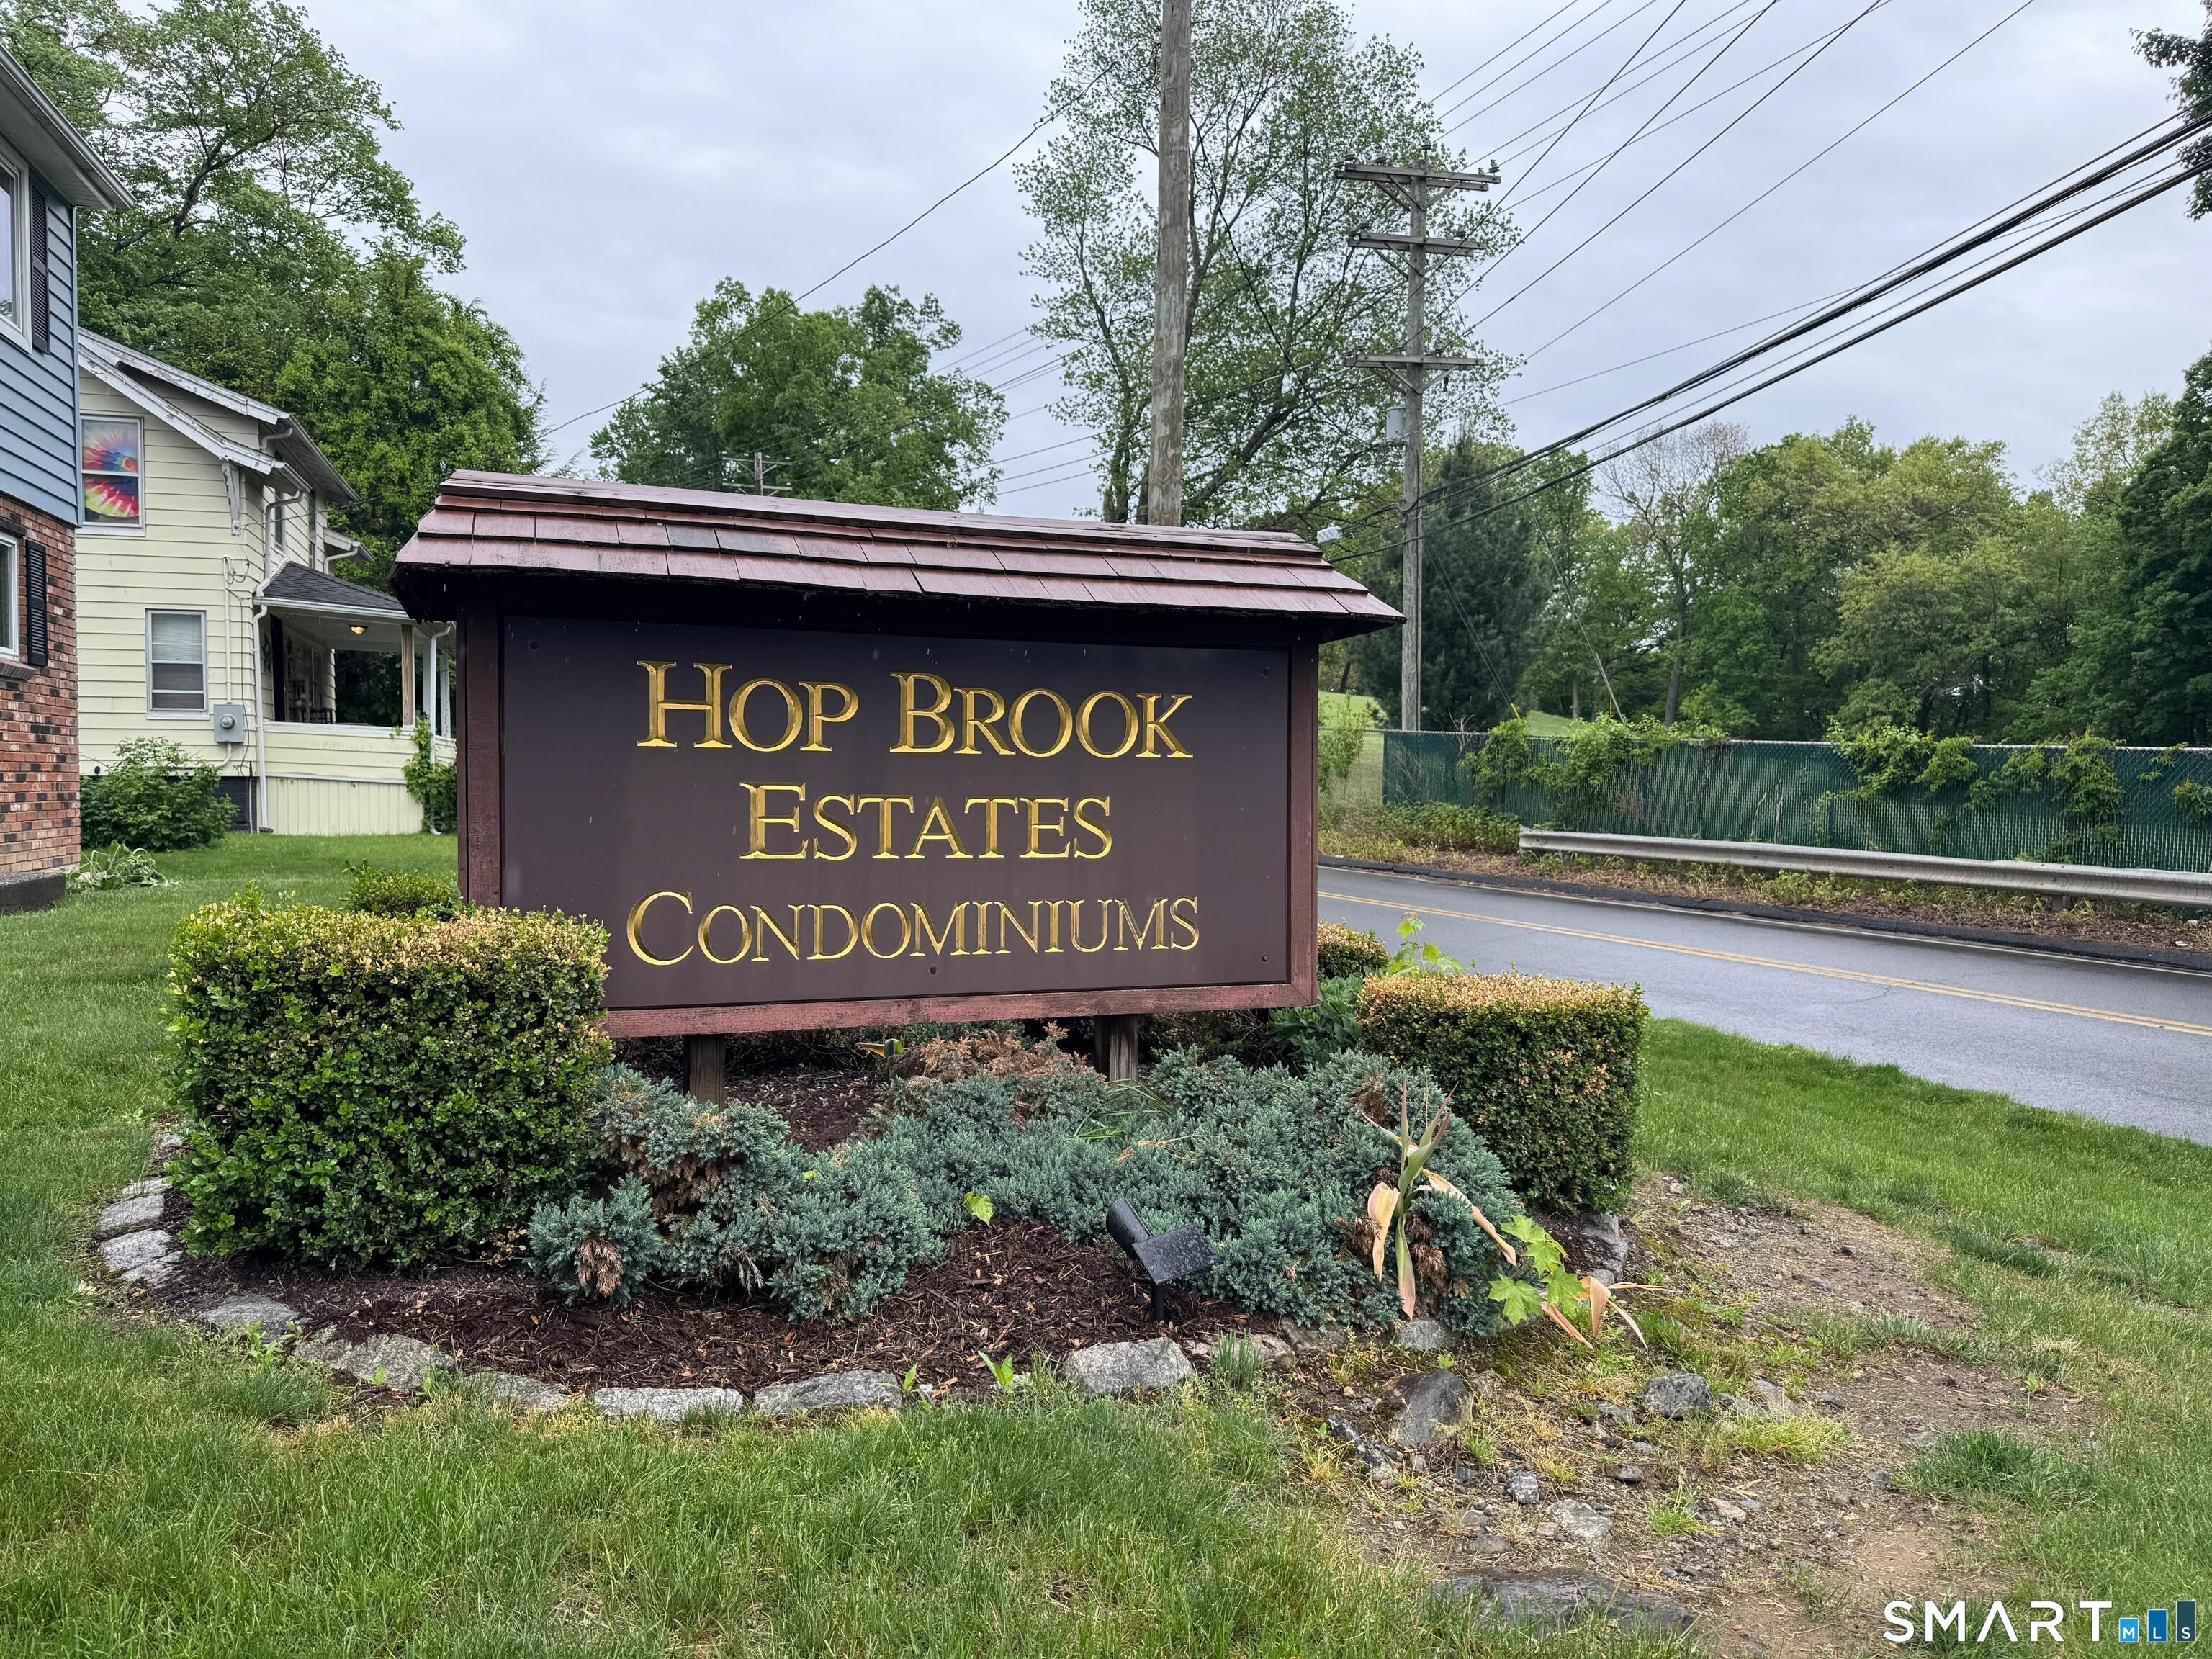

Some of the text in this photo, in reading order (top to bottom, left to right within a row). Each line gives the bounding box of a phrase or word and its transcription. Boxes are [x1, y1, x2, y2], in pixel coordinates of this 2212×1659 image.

[637, 660, 1195, 758] HOP BROOK
[739, 781, 1113, 861] ESTATES
[626, 890, 1200, 966] CONDOMINIUMS
